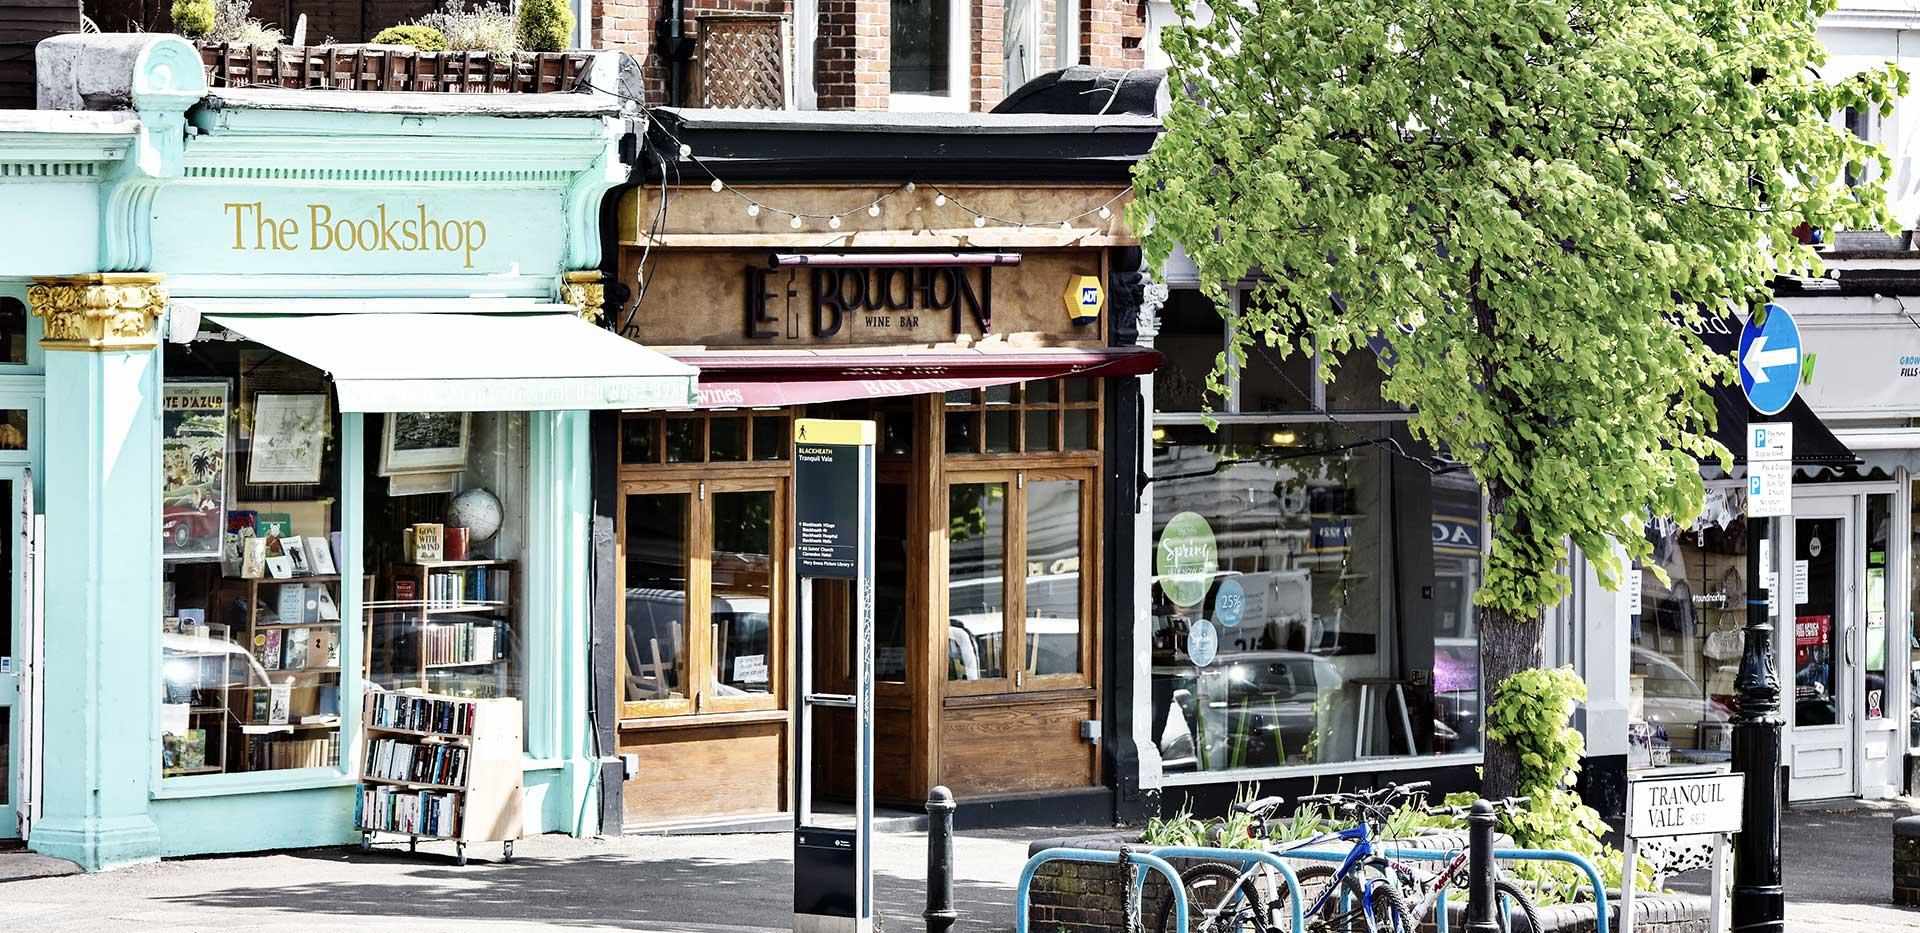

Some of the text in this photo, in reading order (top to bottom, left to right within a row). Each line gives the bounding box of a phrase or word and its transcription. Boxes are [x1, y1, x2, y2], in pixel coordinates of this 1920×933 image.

[224, 202, 487, 269] The Bookshop
[745, 265, 993, 339] LE BOUCHON
[1083, 290, 1097, 303] ADT
[865, 316, 919, 328] WINE BAR
[163, 396, 179, 408] TE
[799, 447, 832, 455] BLACKHEATH
[419, 535, 438, 543] WITH
[421, 543, 440, 551] WIND
[1163, 538, 1209, 568] Spring
[1221, 594, 1241, 609] 25%
[1648, 783, 1725, 807] TRANQUIL
[1648, 807, 1685, 828] VALE
